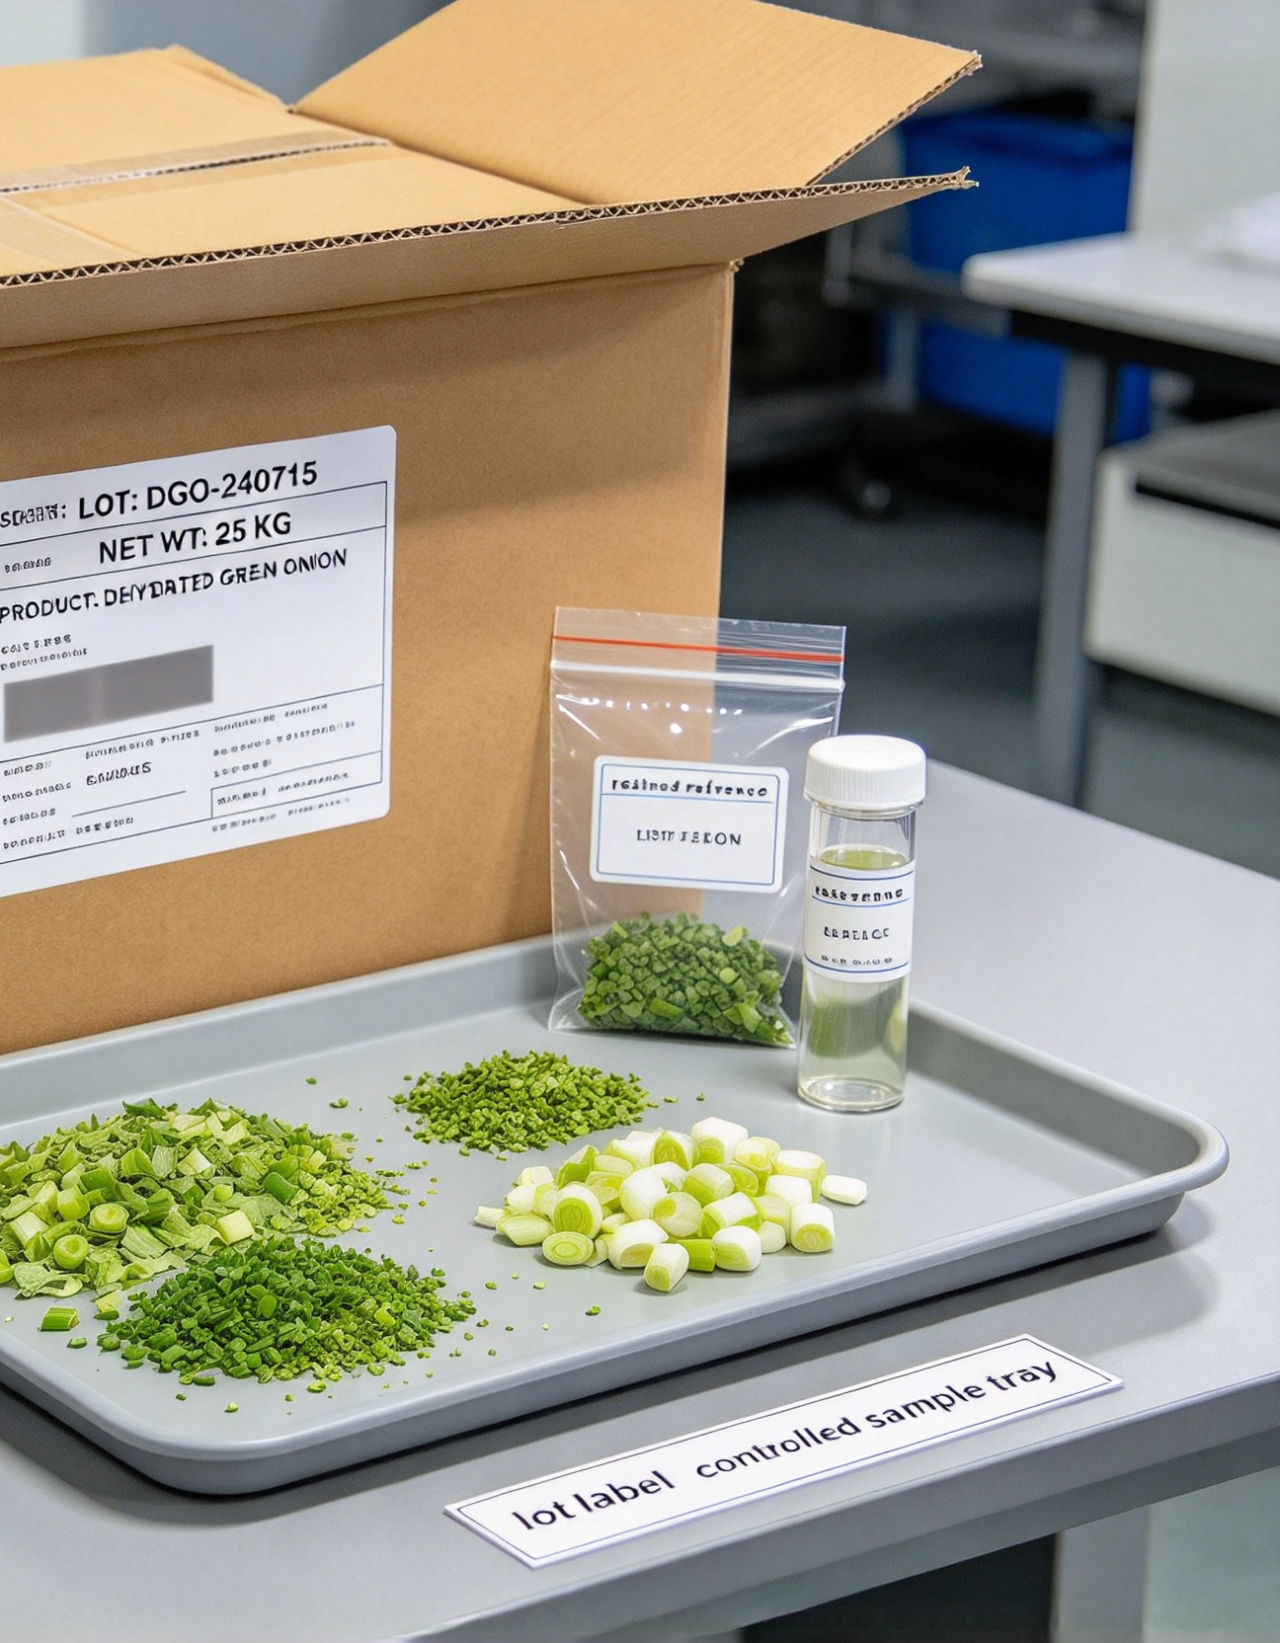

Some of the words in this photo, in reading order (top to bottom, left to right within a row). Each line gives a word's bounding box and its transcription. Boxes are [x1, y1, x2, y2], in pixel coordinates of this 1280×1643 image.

[79, 489, 138, 520] LOT:
[146, 460, 318, 510] DGO-240715
[99, 533, 154, 565] NET
[160, 527, 208, 554] WT:
[214, 518, 247, 546] 25
[254, 511, 292, 540] KG
[511, 1501, 577, 1530] lot
[572, 1470, 676, 1513] label
[696, 1417, 862, 1478] controlled
[865, 1385, 986, 1428] sample
[986, 1361, 1057, 1391] tray
